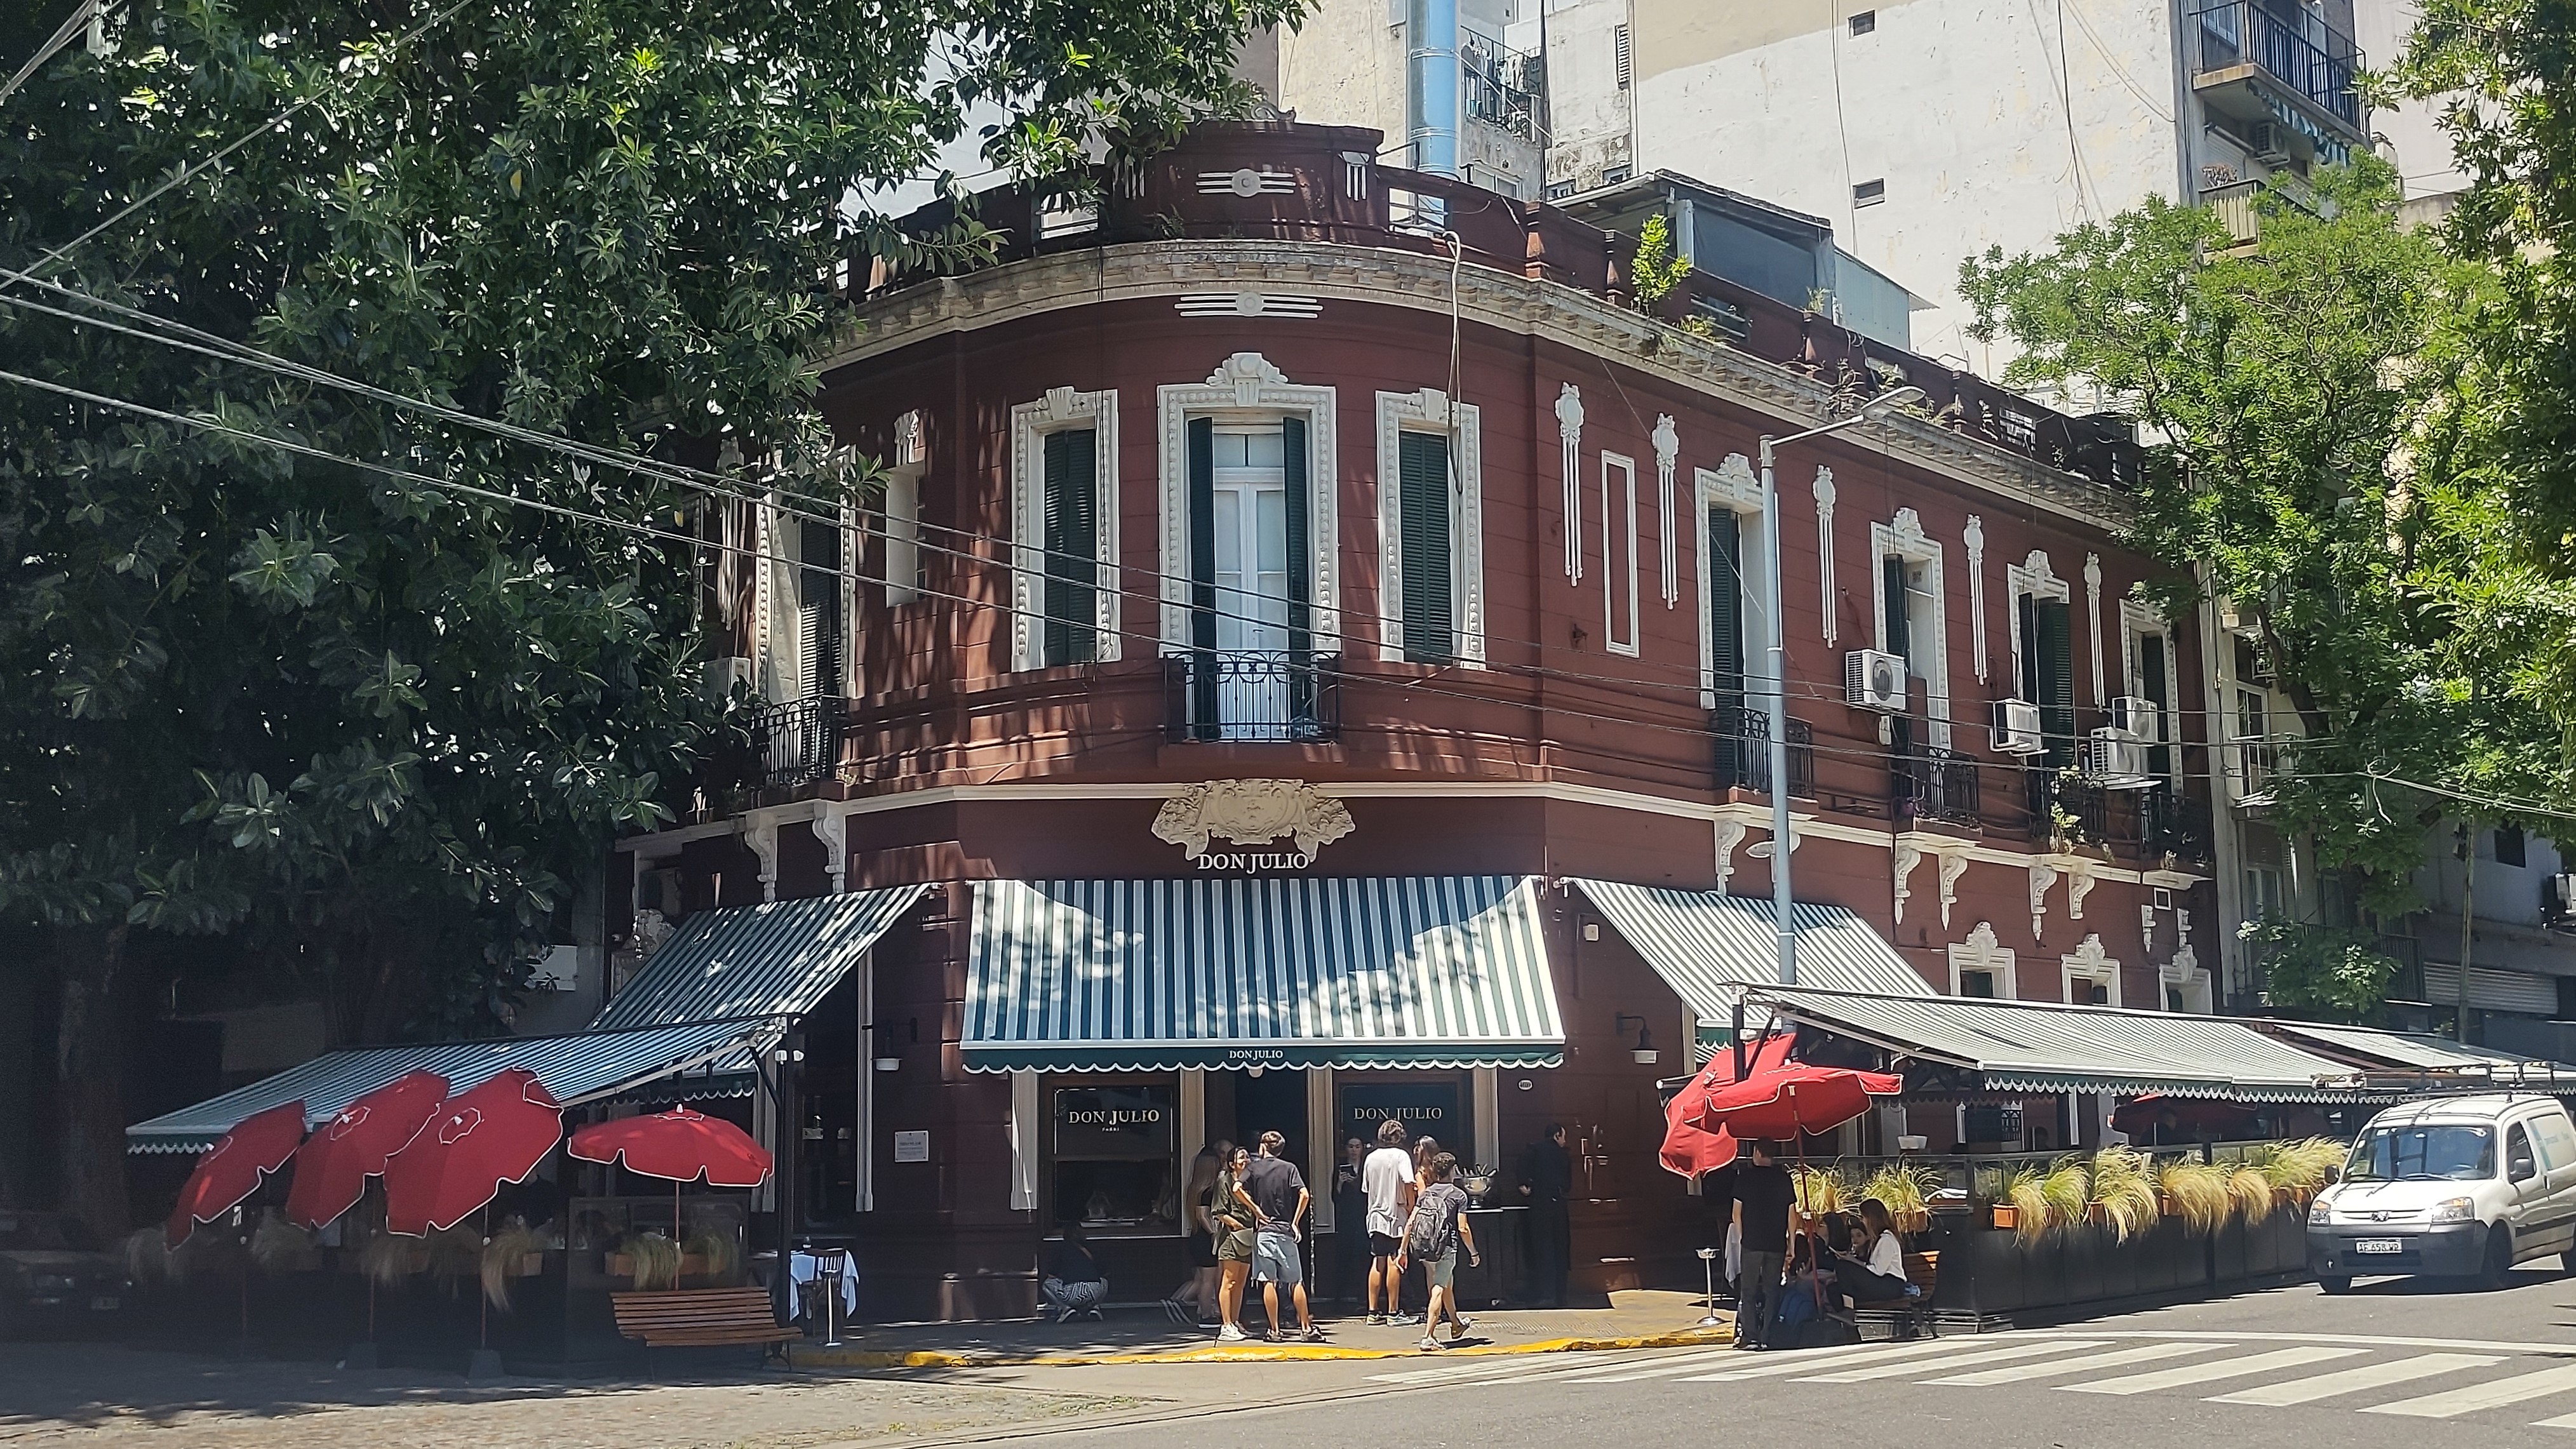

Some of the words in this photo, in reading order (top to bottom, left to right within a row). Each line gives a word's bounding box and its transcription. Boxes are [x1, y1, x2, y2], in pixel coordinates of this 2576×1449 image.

[1197, 853, 1246, 870] DON
[1246, 853, 1309, 874] JULIO
[1229, 1050, 1252, 1059] DON
[1252, 1050, 1284, 1060] JULIO
[1068, 1111, 1106, 1124] DON
[1109, 1109, 1160, 1125] JULIO
[1353, 1107, 1390, 1120] DON
[1395, 1107, 1442, 1121] JULIO
